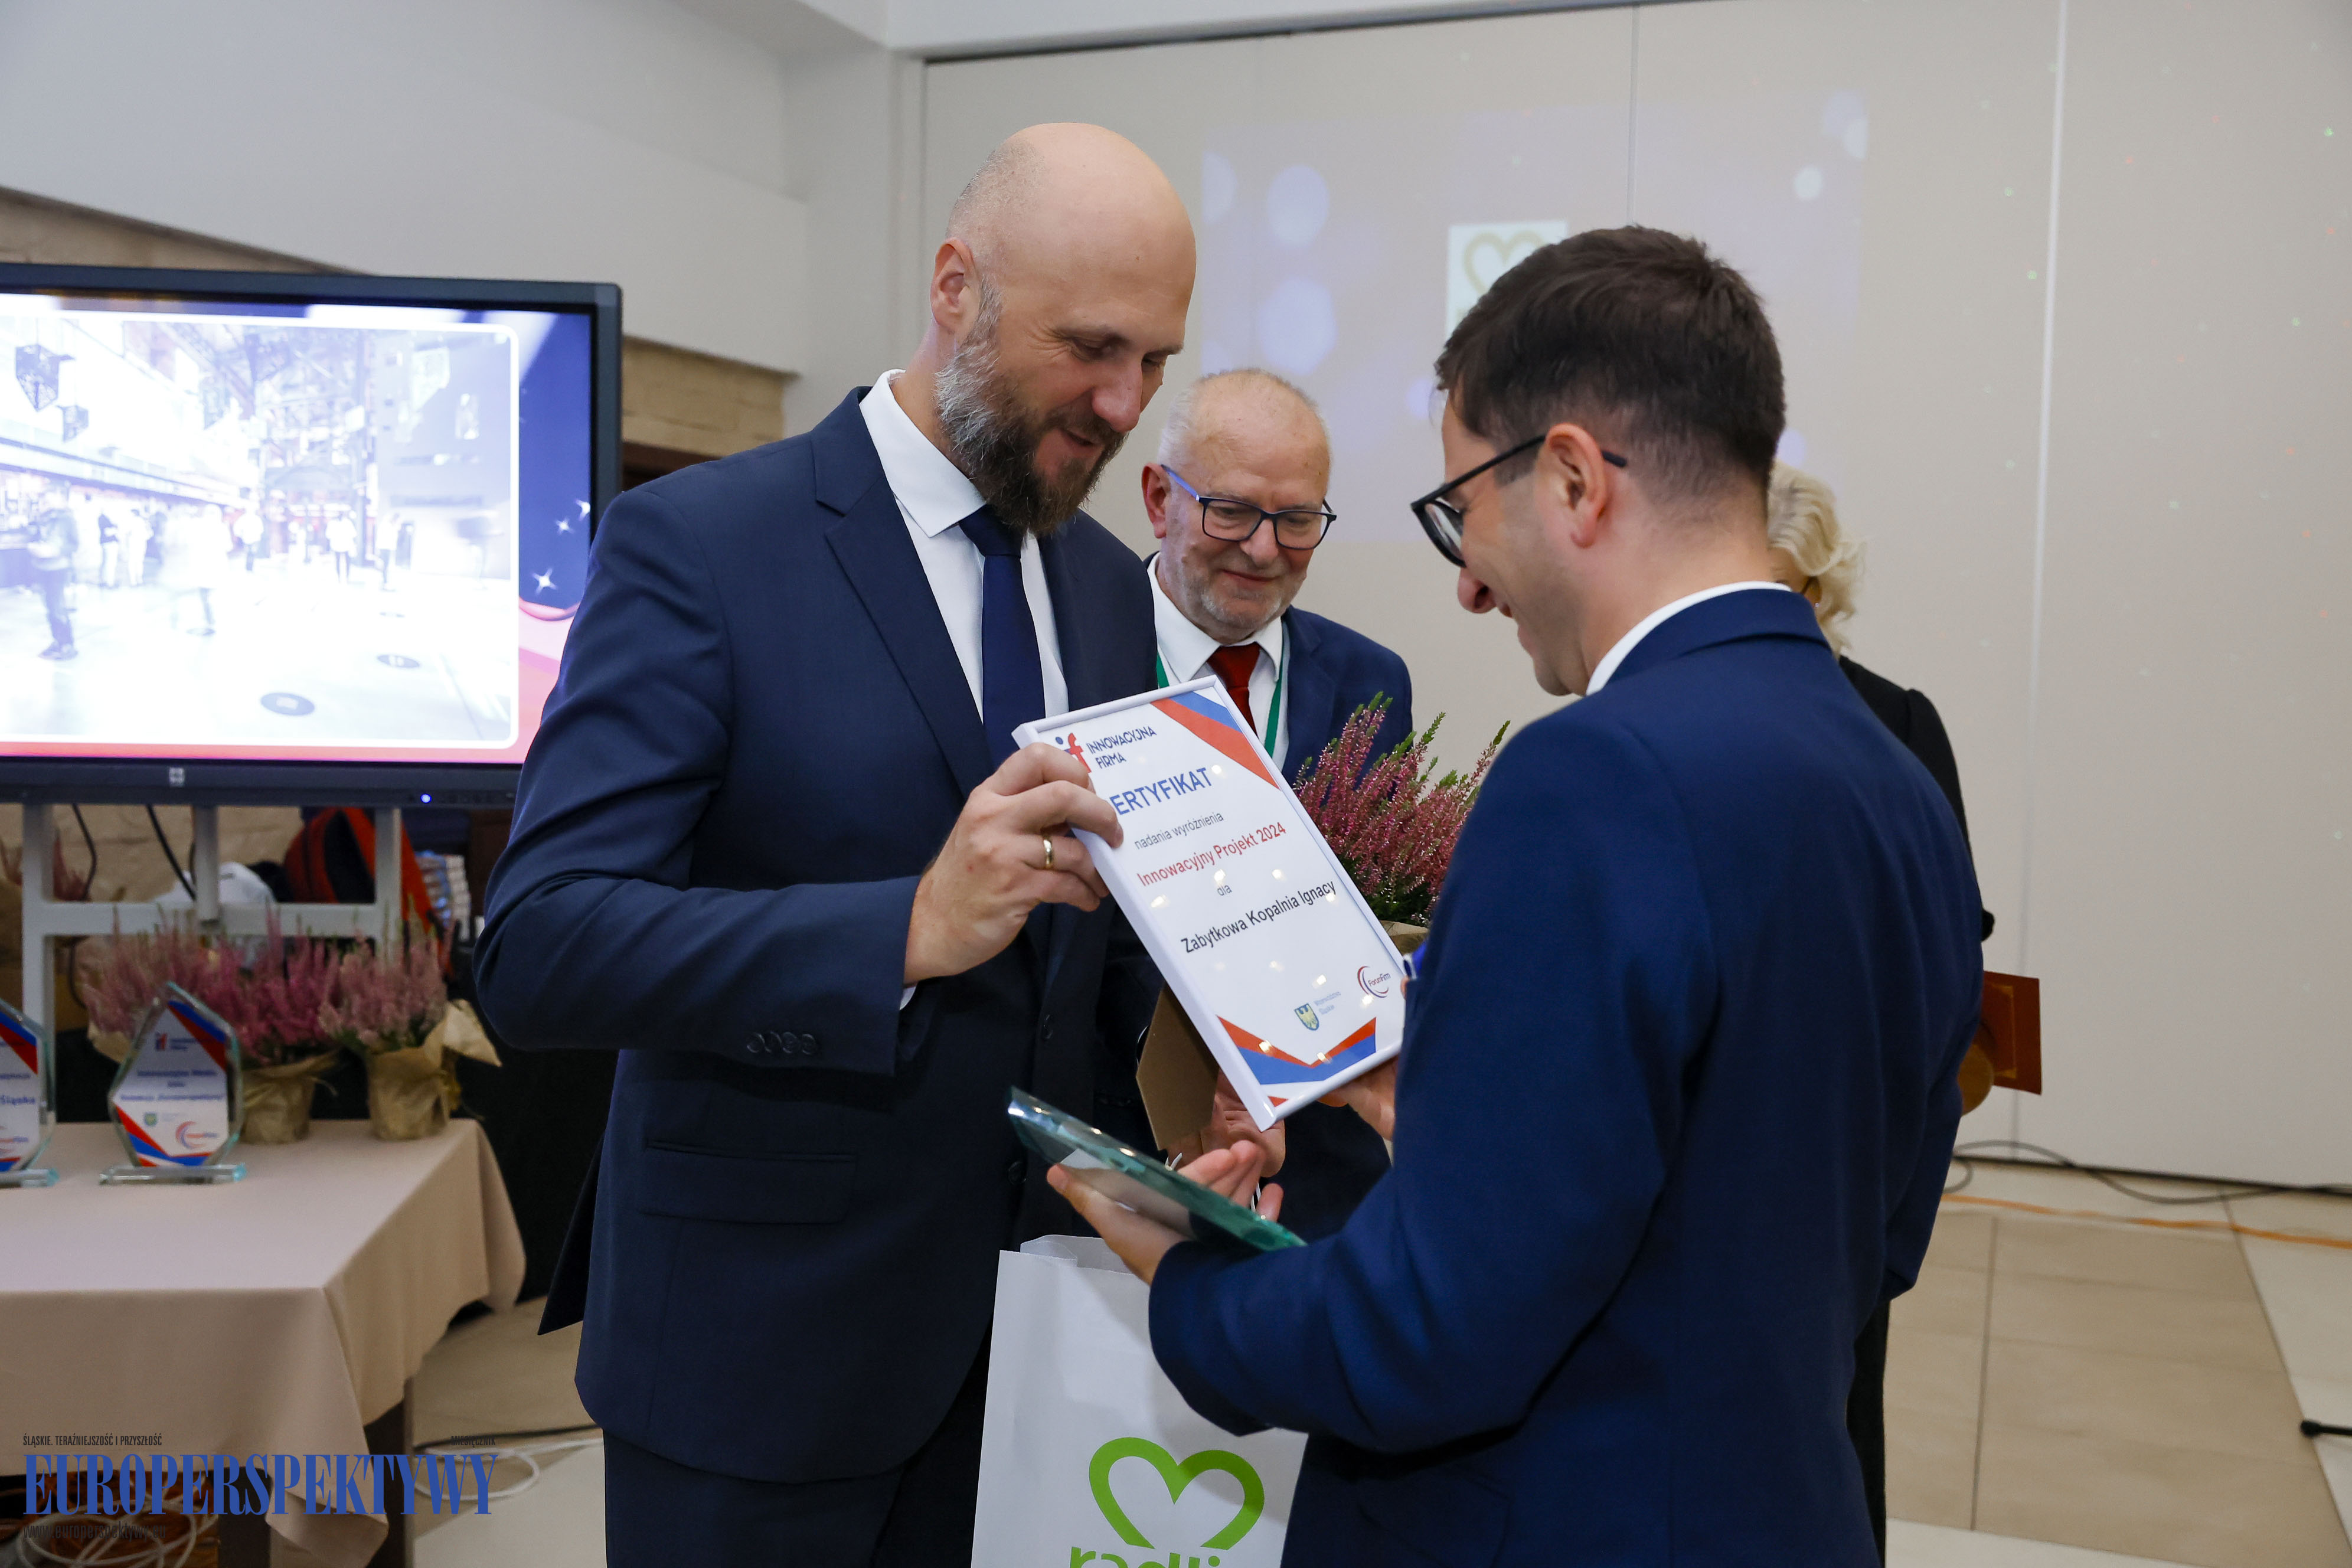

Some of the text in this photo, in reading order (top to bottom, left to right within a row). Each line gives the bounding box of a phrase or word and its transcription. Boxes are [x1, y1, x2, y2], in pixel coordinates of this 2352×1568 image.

[1086, 726, 1157, 754] INNOWACYJNA
[1095, 752, 1126, 769] FIRMA
[1110, 767, 1211, 815] ERTYFIKAT
[1134, 812, 1224, 850] nadania wyróżnienia
[1137, 822, 1286, 886] Innowacyjny Projekt 2024
[1217, 884, 1232, 896] dla
[1181, 881, 1337, 953] Zabytkowa Kopalnia Ignacy
